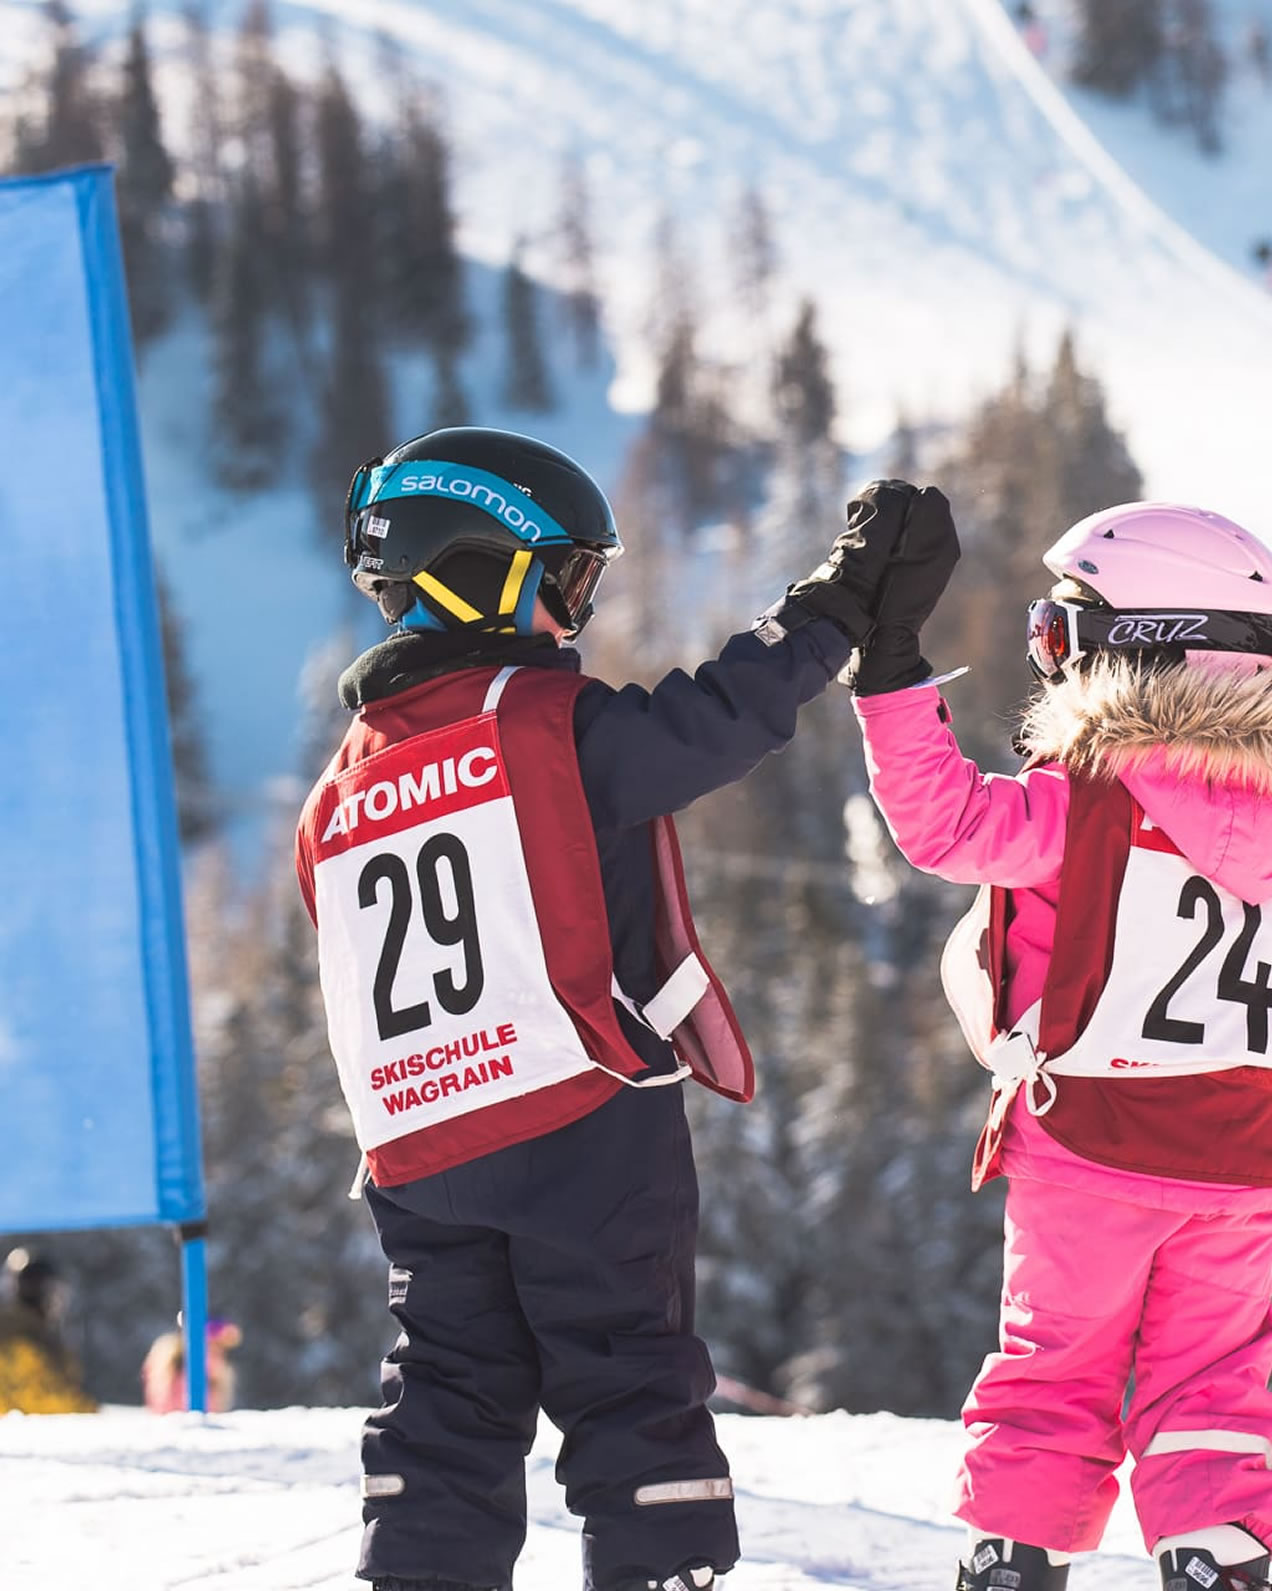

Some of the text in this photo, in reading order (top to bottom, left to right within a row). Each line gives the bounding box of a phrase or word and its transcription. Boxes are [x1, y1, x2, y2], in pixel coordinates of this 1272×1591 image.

[1108, 614, 1209, 645] CRUZ
[321, 746, 498, 843] ATOMIC
[358, 832, 485, 1041] 29
[371, 1023, 517, 1090] SKISCHULE
[382, 1055, 514, 1115] WAGRAIN
